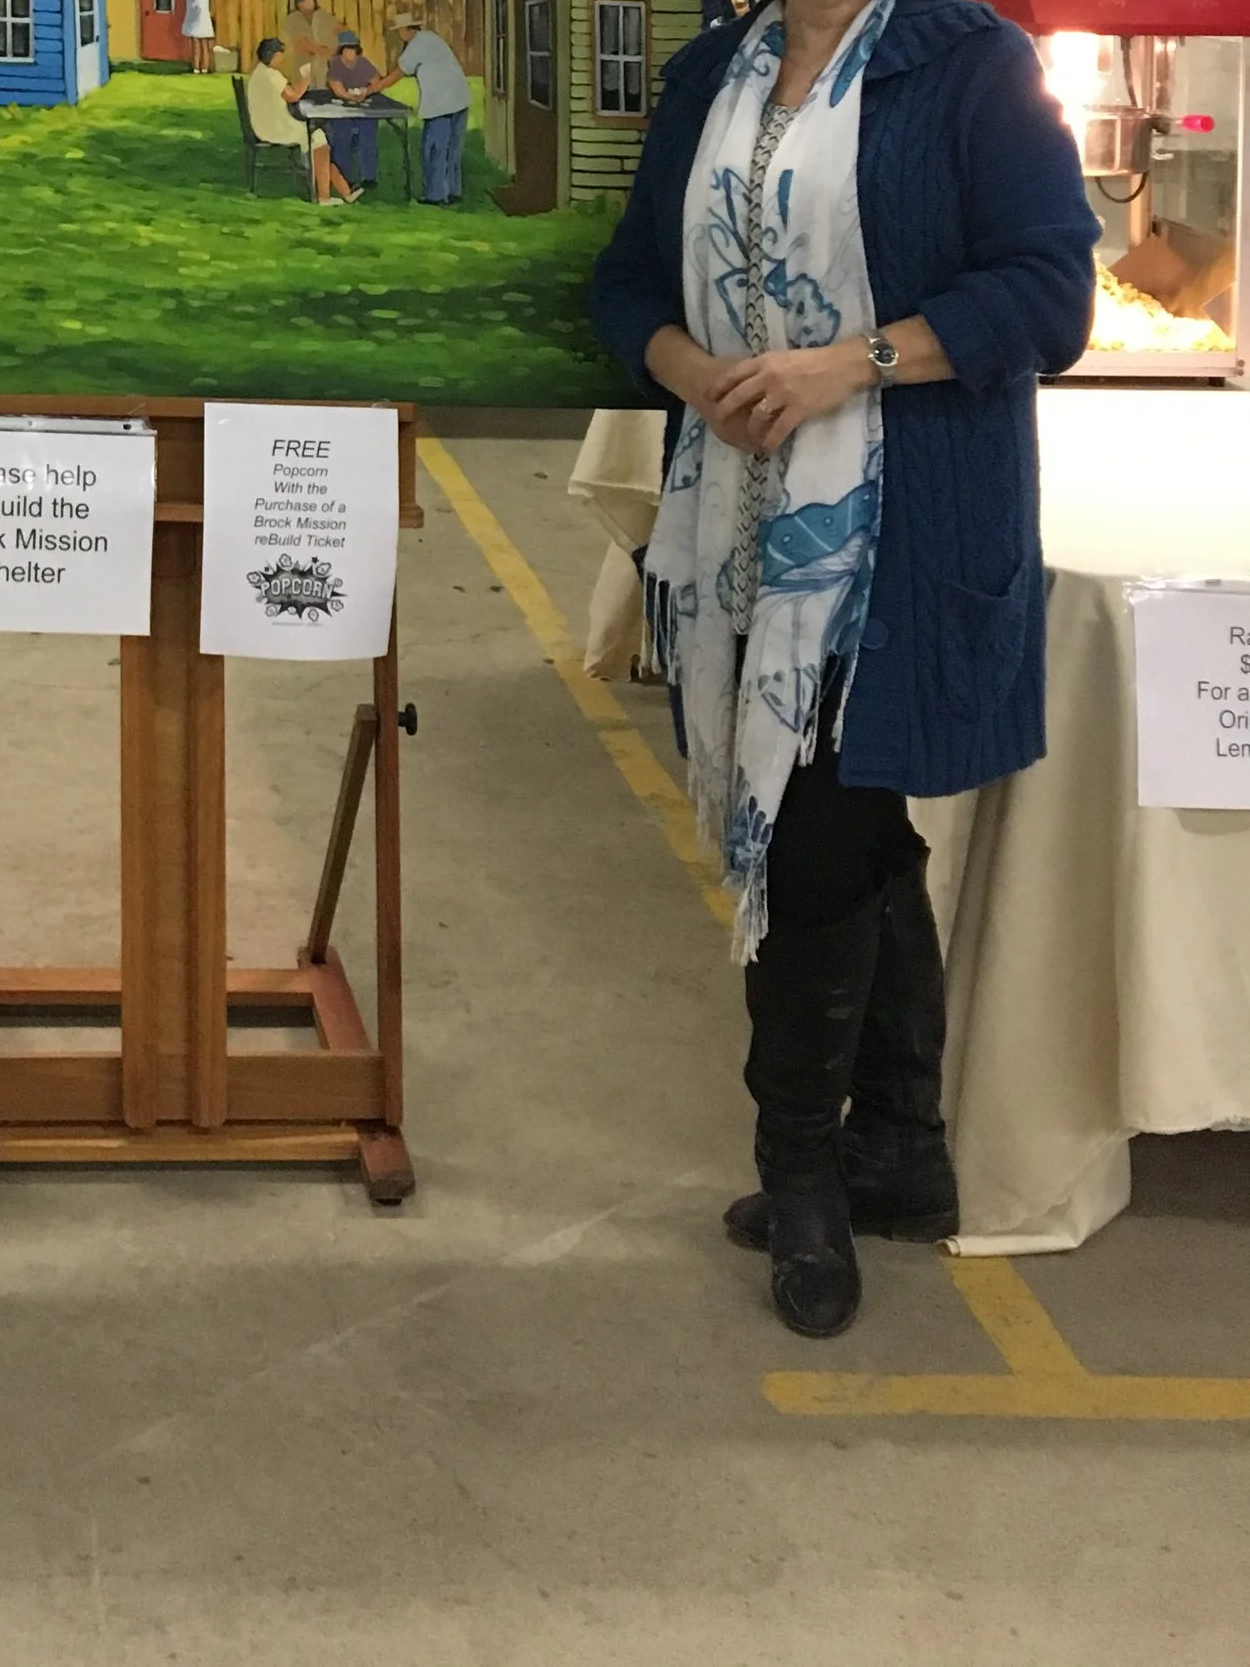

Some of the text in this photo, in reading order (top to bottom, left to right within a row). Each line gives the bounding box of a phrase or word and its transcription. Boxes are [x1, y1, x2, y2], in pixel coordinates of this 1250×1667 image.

[271, 439, 331, 459] FREE
[46, 463, 97, 491] help
[273, 463, 329, 479] Popcorn
[274, 481, 328, 495] With the
[51, 497, 90, 520] the
[254, 498, 347, 513] Purchase of a
[254, 515, 347, 531] Brock Mission
[15, 528, 109, 553] Mission
[254, 533, 346, 549] reBuild Ticket
[261, 579, 334, 599] POPCORN
[1197, 682, 1231, 701] For
